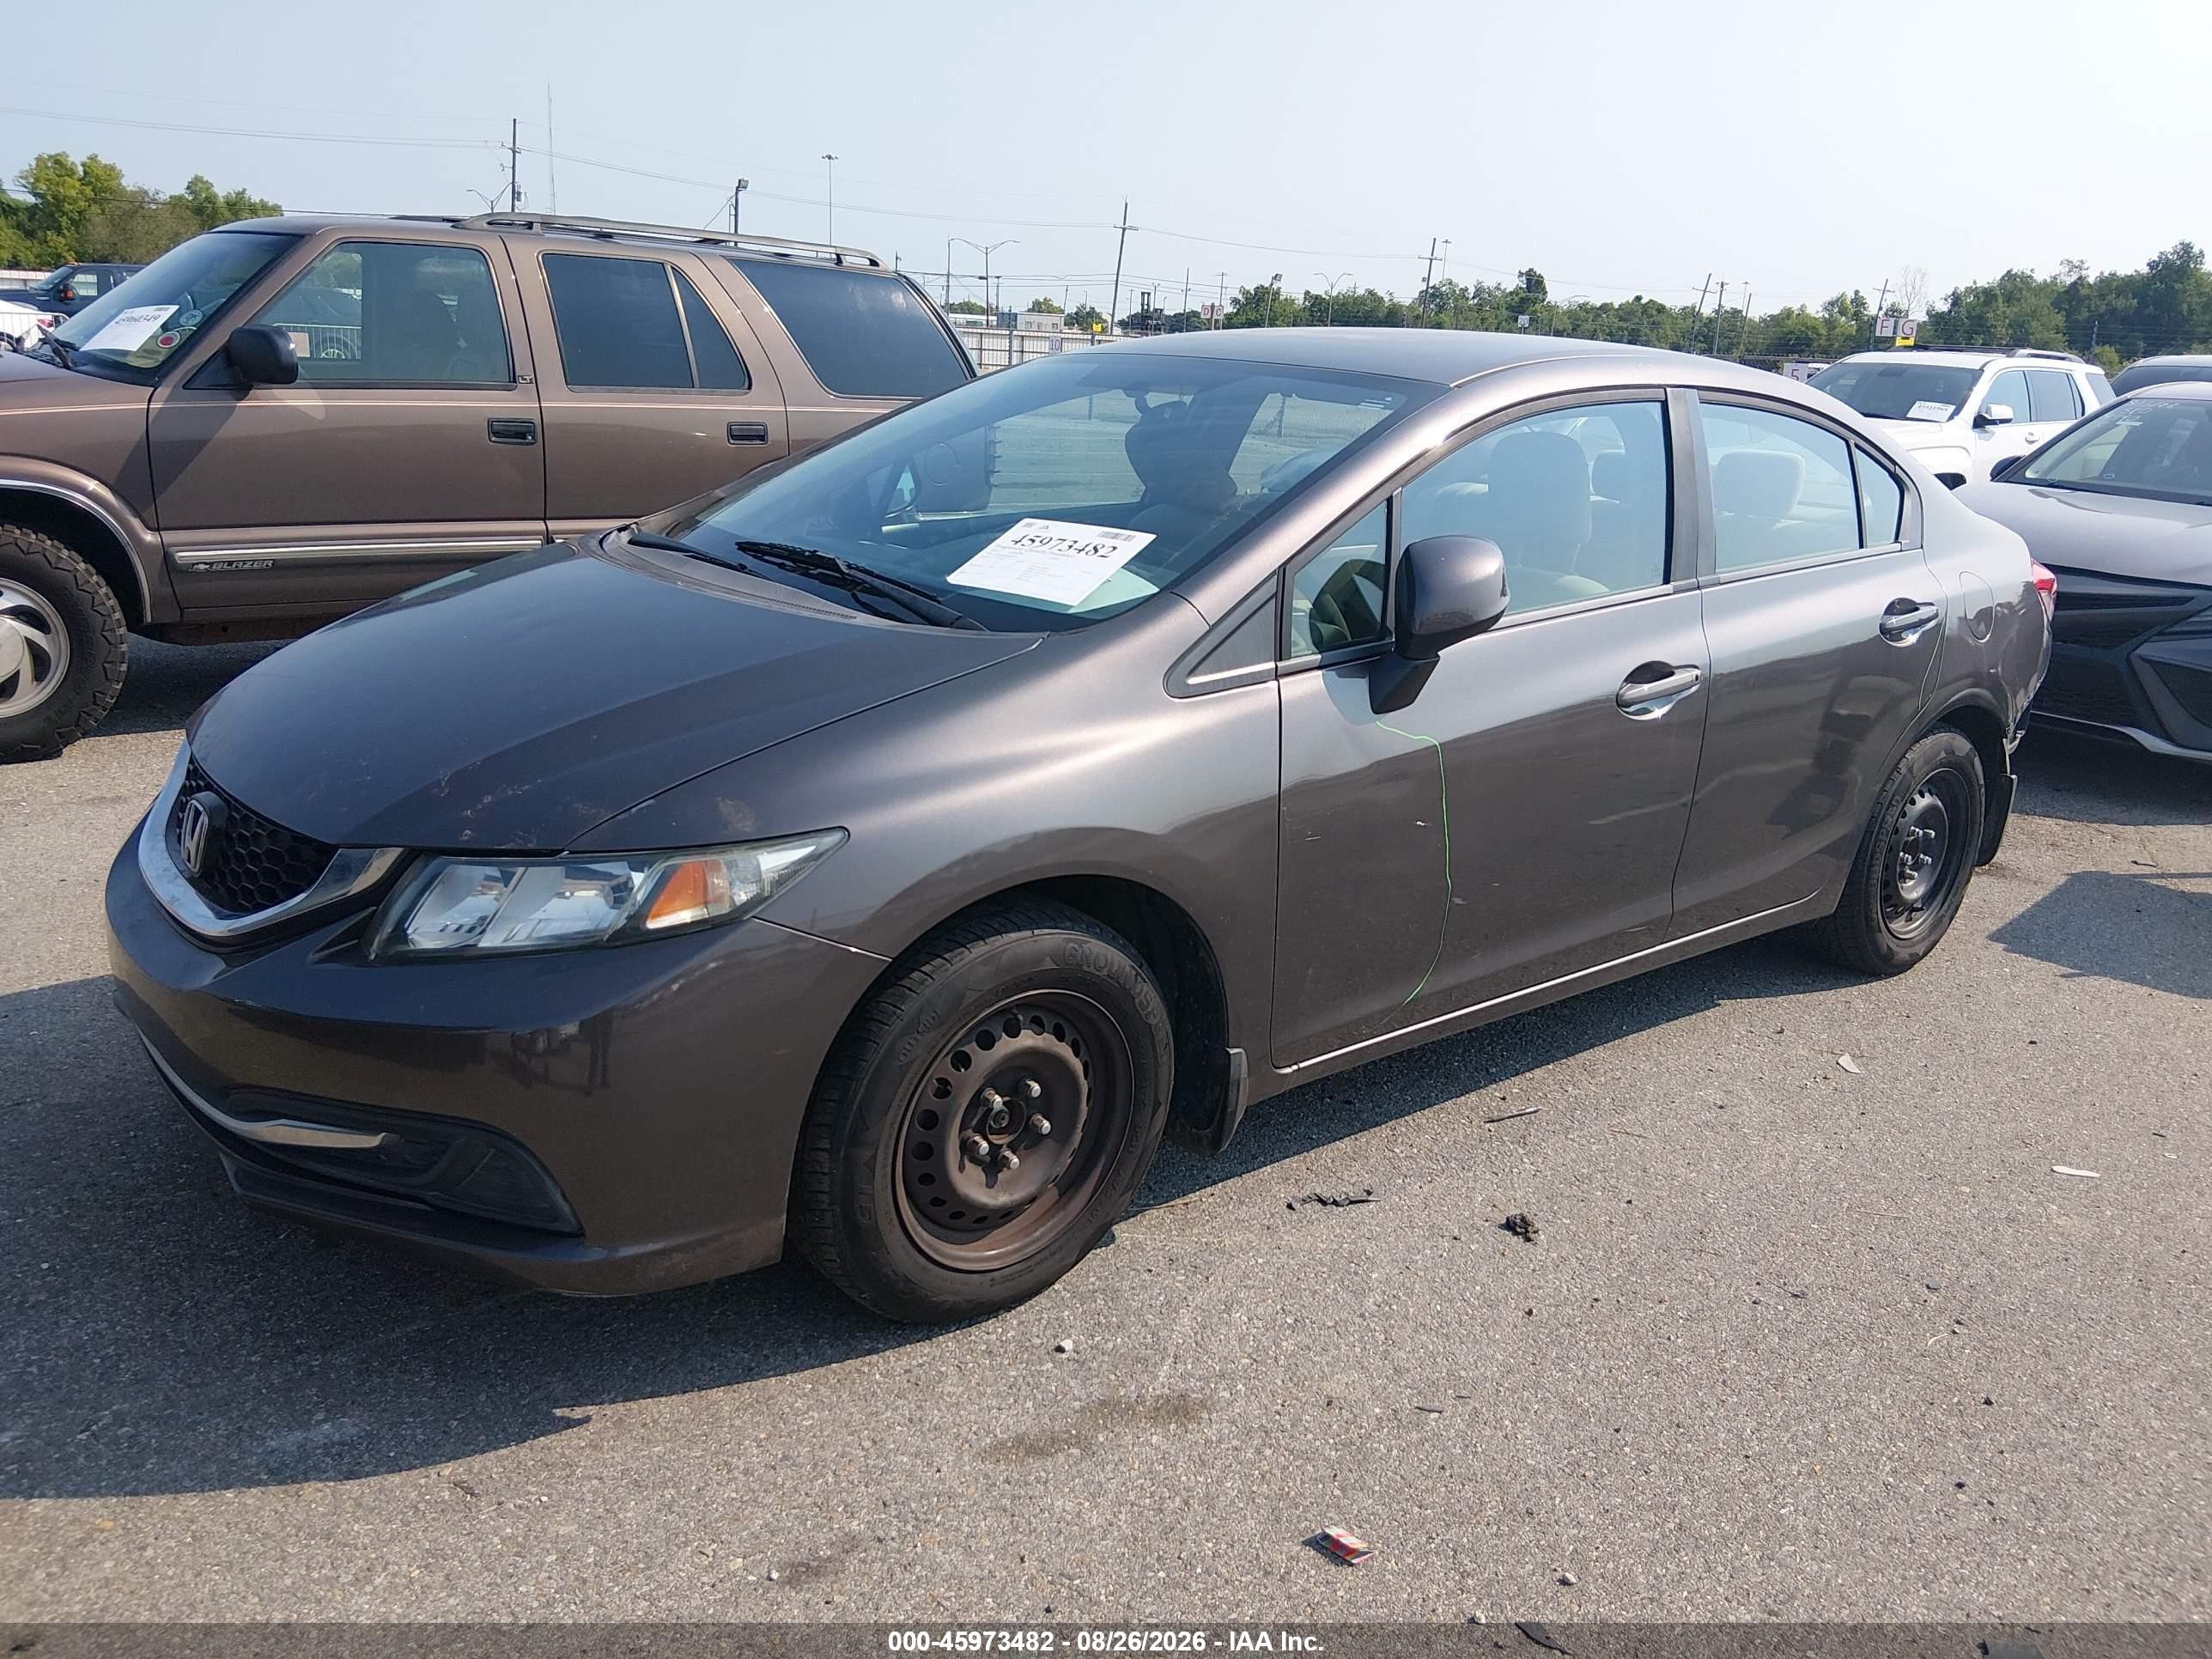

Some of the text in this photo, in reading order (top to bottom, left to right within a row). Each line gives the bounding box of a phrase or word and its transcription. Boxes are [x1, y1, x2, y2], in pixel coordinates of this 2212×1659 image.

[1881, 319, 1890, 336] F
[1902, 319, 1914, 336] G
[1049, 338, 1060, 351] 10
[1791, 368, 1800, 381] 5
[1011, 533, 1119, 558] 45973482
[212, 560, 274, 569] BLAZER
